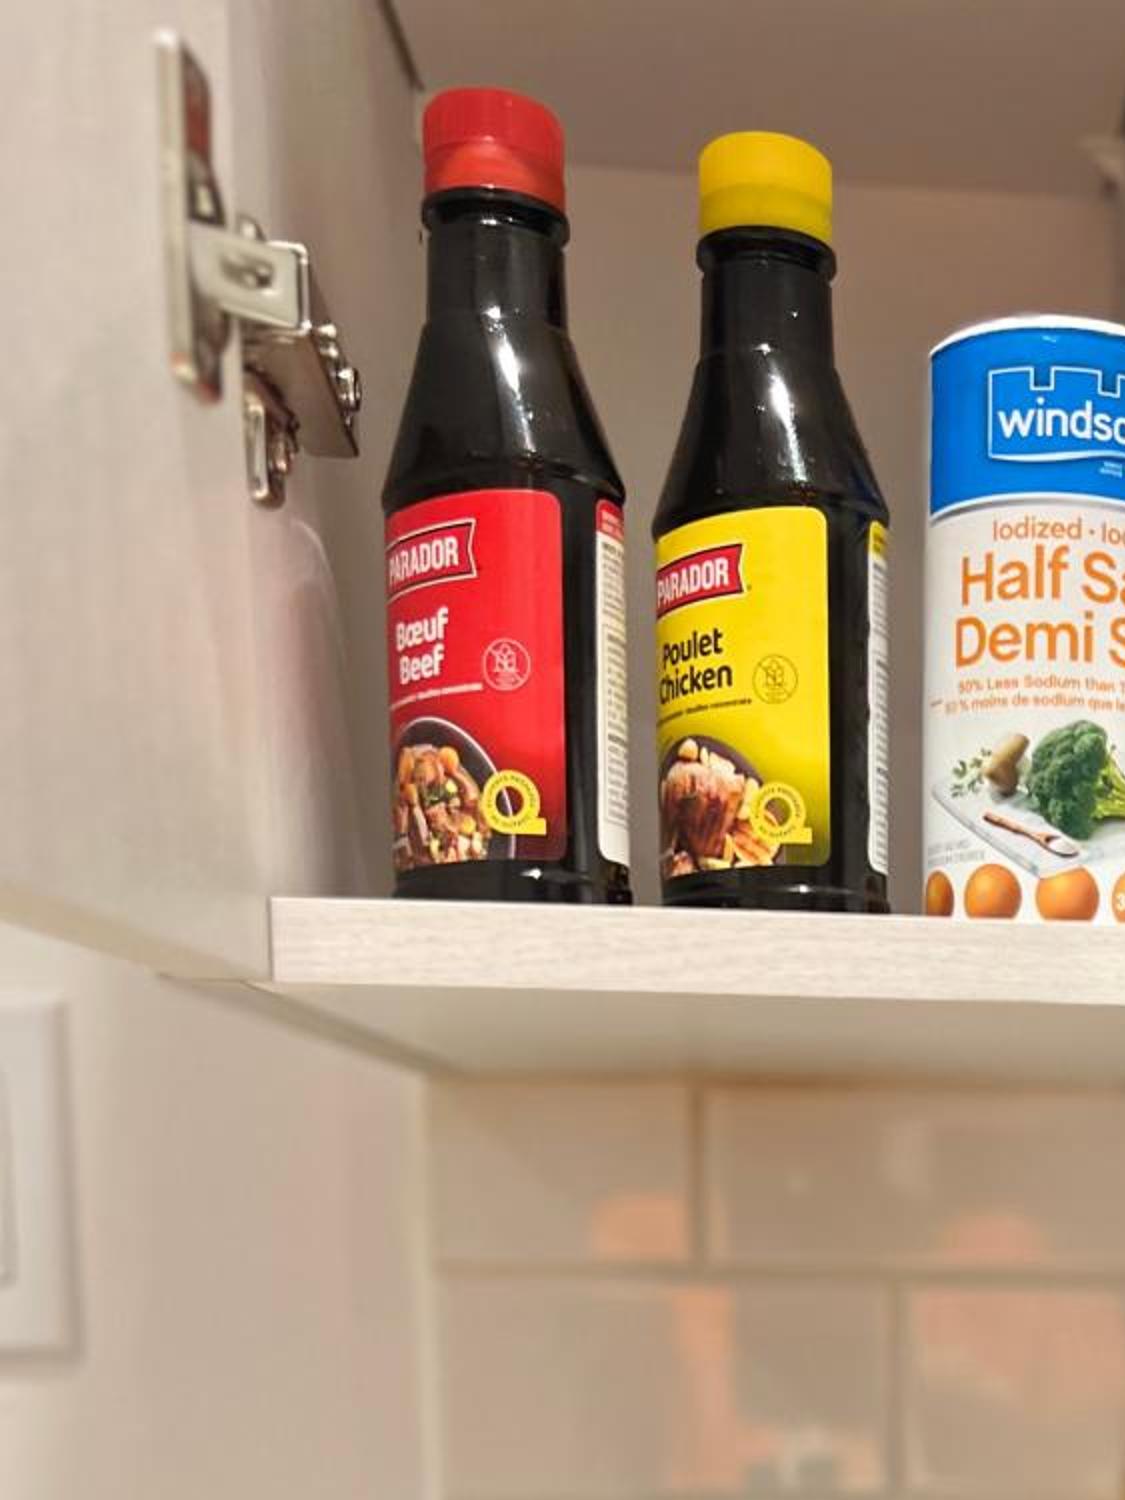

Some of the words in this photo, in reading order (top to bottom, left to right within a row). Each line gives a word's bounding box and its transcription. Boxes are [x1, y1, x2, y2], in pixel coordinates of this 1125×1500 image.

[993, 516, 1082, 542] Iodized
[389, 536, 460, 586] PARADOR
[657, 557, 730, 606] PARADOR
[961, 545, 1070, 607] Half
[395, 606, 449, 652] Bœuf
[662, 627, 723, 671] Poulet
[955, 611, 1093, 668] Demi
[400, 643, 445, 685] Beef
[659, 664, 733, 705] Chicken
[1023, 674, 1081, 689] Sodium
[1032, 692, 1085, 705] sodium
